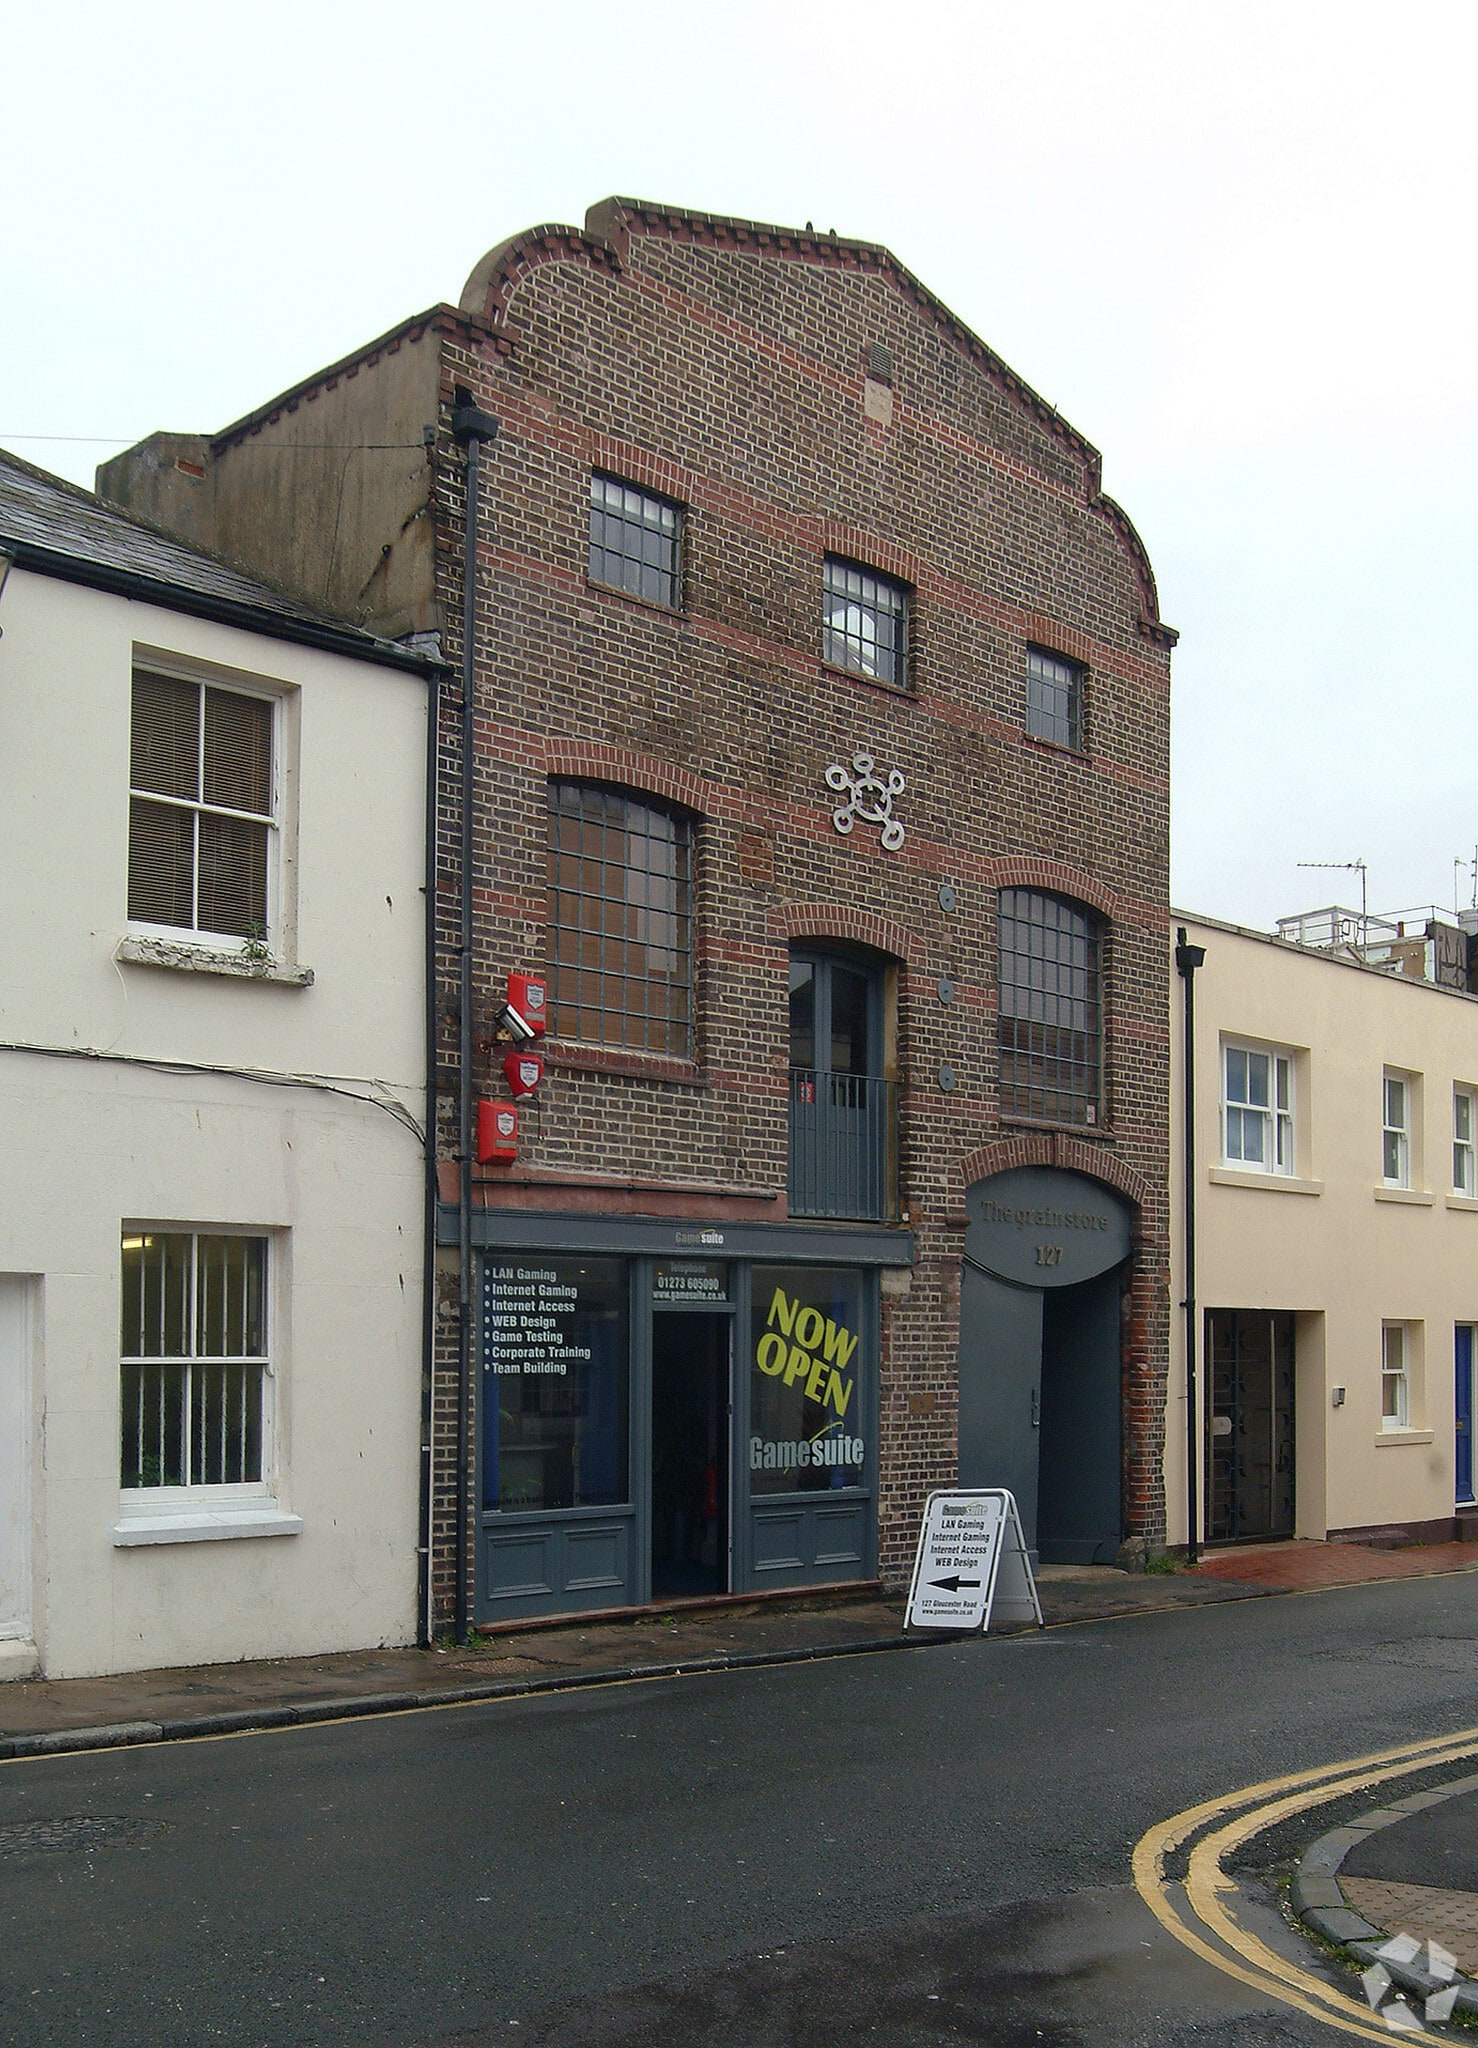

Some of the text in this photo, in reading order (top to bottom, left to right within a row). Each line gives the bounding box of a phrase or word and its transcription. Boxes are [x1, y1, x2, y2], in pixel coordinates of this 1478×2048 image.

[1036, 1246, 1064, 1265] 127
[492, 1267, 557, 1282] LAN Gaming
[670, 1262, 707, 1274] Telephone
[658, 1277, 719, 1290] 01273 605090
[492, 1283, 577, 1299] Internet Gaming
[652, 1290, 726, 1302] www.gamesuite.co.uk
[492, 1299, 576, 1312] Internet Access
[492, 1315, 556, 1329] WEB Design
[766, 1286, 859, 1370] NOW
[492, 1330, 563, 1344] Game Testing
[492, 1346, 591, 1360] Corporate Training
[492, 1362, 567, 1375] Team Building
[756, 1332, 854, 1417] OPEN
[750, 1433, 865, 1470] Gamesuite
[941, 1520, 985, 1531] LAN Gaming
[931, 1532, 990, 1543] Internet Gaming
[930, 1545, 987, 1554] Internet Access
[935, 1558, 978, 1569] WEB Design
[921, 1600, 977, 1608] 127 Gloucester Road
[922, 1608, 974, 1616] www.gamesuite.co.uk
